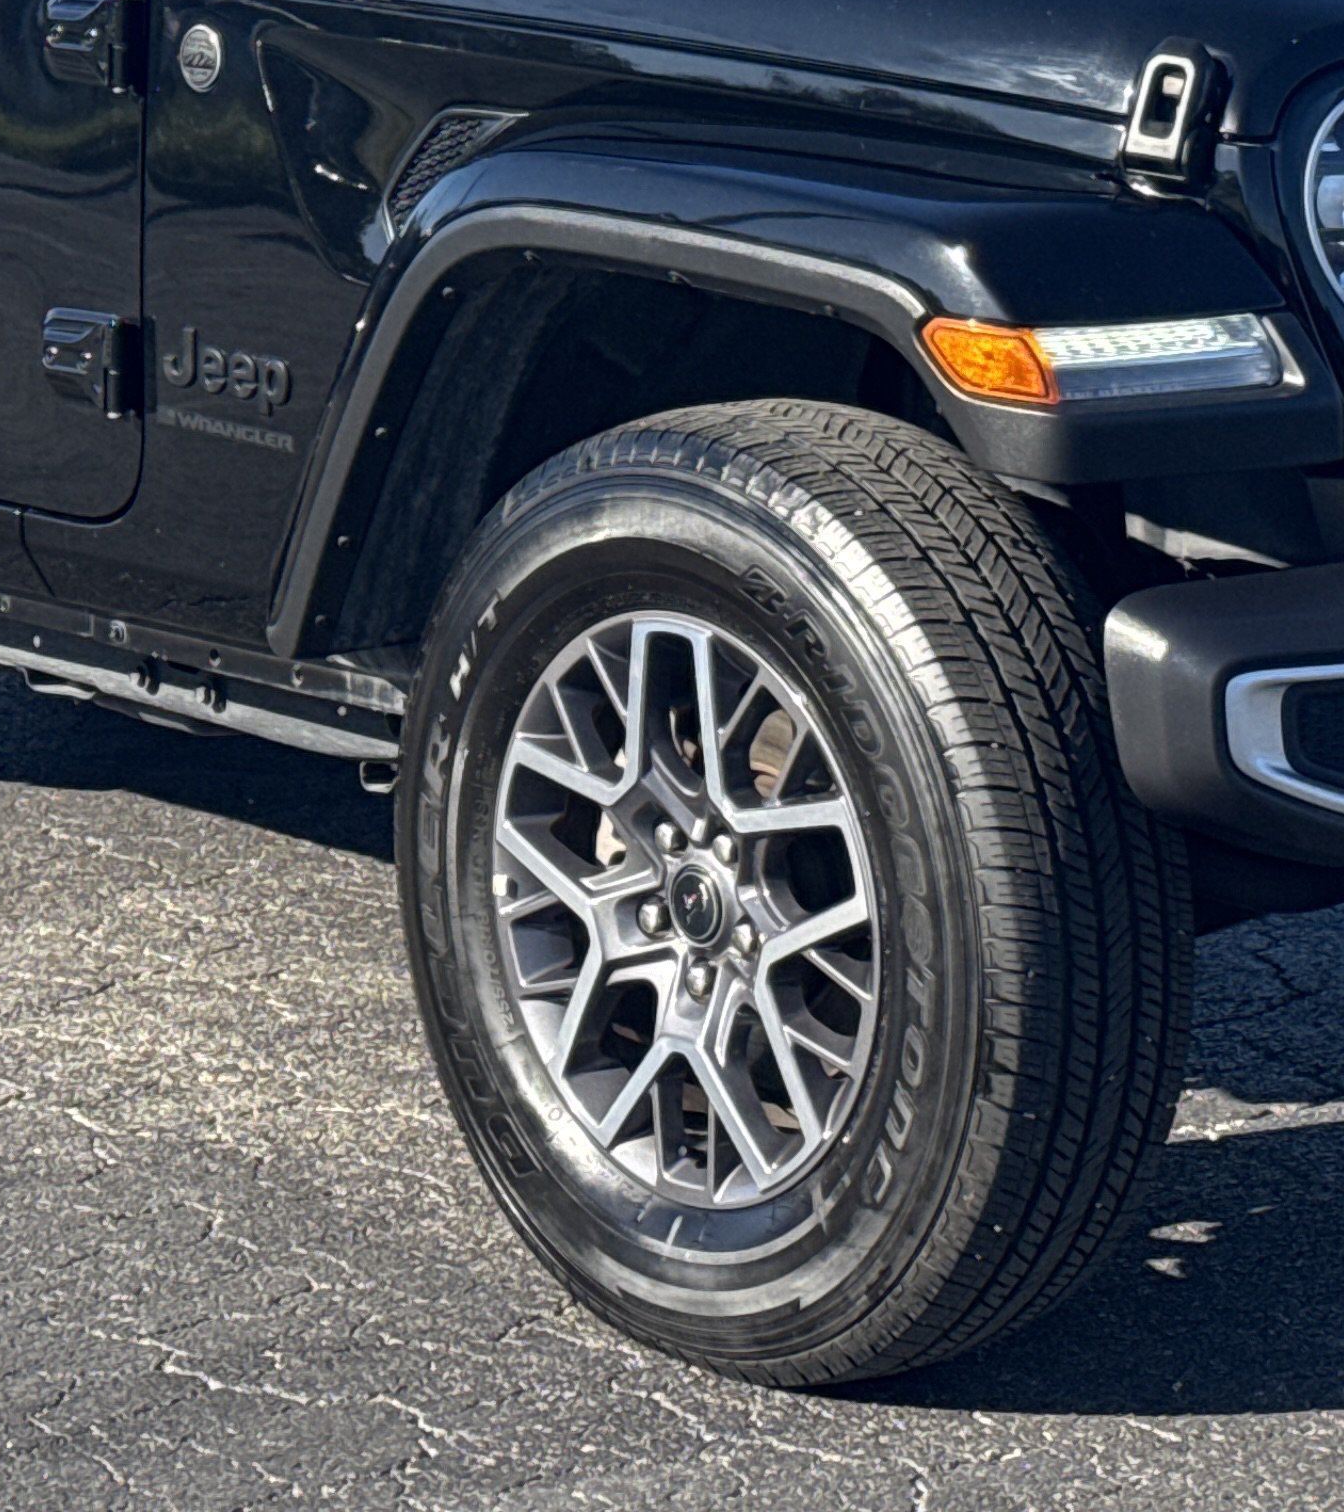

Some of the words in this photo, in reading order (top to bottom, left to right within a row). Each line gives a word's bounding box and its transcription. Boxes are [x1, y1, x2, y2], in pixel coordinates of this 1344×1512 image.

[163, 327, 292, 418] Jeep
[176, 411, 294, 453] WRANGLER
[449, 586, 503, 701] H/T
